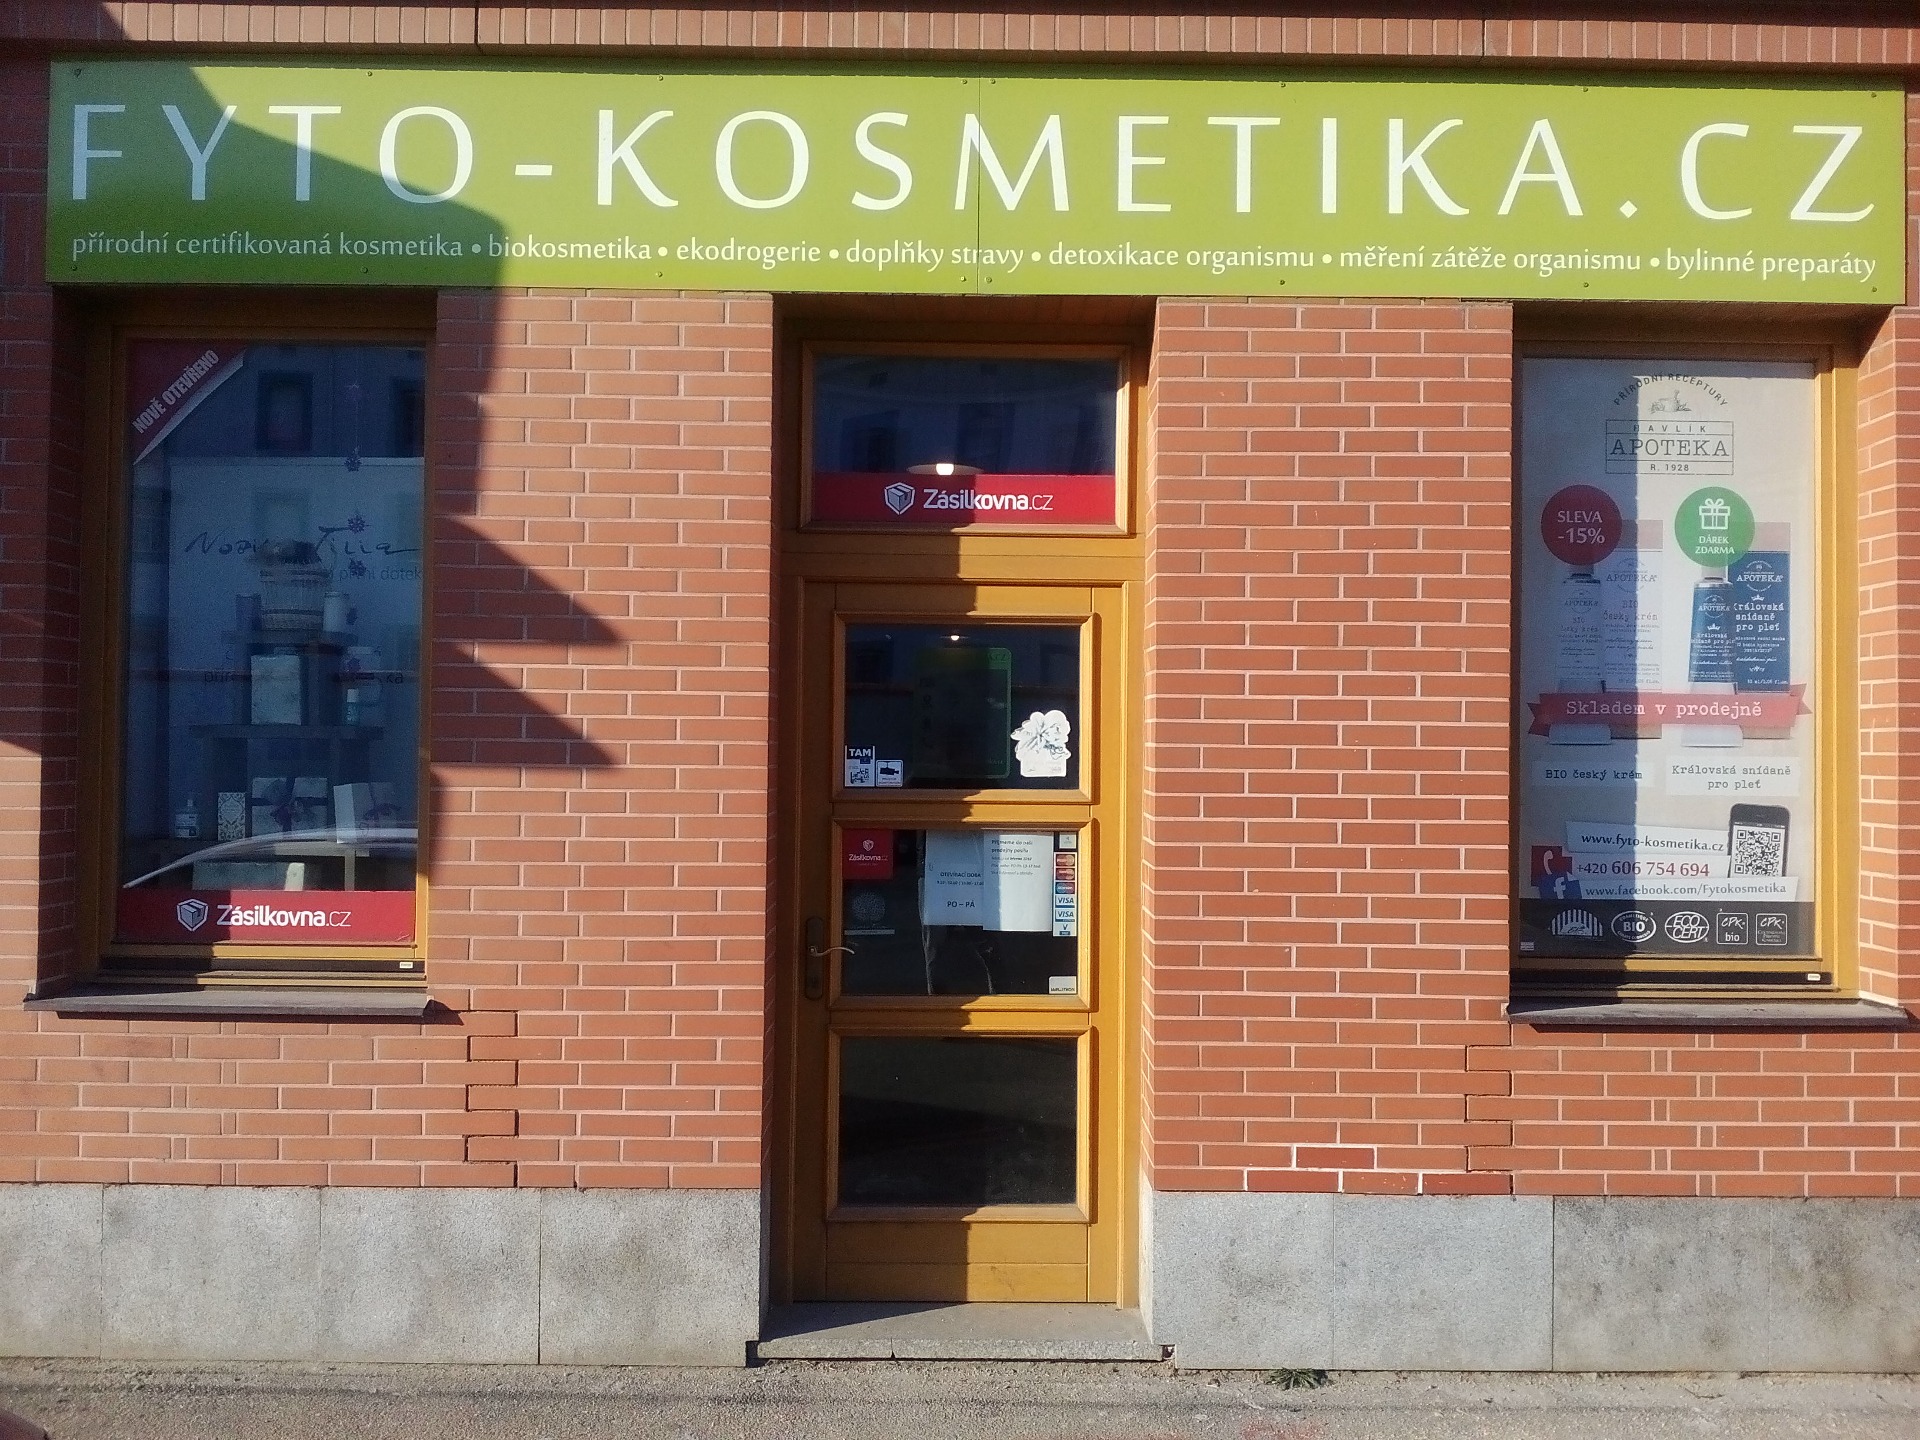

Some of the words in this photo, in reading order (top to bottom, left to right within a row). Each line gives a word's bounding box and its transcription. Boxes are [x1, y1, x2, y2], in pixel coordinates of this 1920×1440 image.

[72, 103, 1875, 225] FYTO-KOSMETIKA.CZ
[72, 232, 168, 260] přírodní
[175, 231, 331, 256] certifikovaná
[339, 232, 463, 257] kosmetika
[489, 234, 652, 261] biokosmetika
[676, 238, 821, 270] ekodrogerie
[846, 240, 944, 272] doplňky
[951, 244, 1024, 273] stravy
[1049, 242, 1179, 267] detoxikace
[1186, 246, 1314, 274] organismu
[1340, 244, 1424, 269] měření
[1431, 245, 1507, 269] zátěže
[1514, 248, 1641, 278] organismu
[1666, 247, 1755, 279] bylinné
[1762, 251, 1876, 283] preparáty
[132, 397, 166, 434] NOVĚ
[162, 349, 220, 405] OTEVŘENO
[1668, 373, 1729, 407] RECEPTURY
[1610, 439, 1730, 456] APOTEKA
[1557, 510, 1603, 523] SLEVA
[1557, 528, 1605, 544] -15%
[1699, 534, 1729, 544] DÁREK
[1695, 545, 1735, 555] ZDARMA
[1735, 624, 1754, 633] pro
[1566, 700, 1645, 715] Skladem
[1655, 704, 1667, 714] v
[1676, 702, 1762, 719] prodejně
[849, 748, 872, 757] TAM
[1545, 769, 1568, 779] BIO
[1573, 768, 1607, 781] český
[1613, 768, 1643, 779] krém
[1672, 765, 1737, 776] Královská
[1742, 765, 1791, 776] snídaně
[1708, 781, 1729, 790] pro
[1734, 779, 1762, 790] pleť
[1581, 833, 1725, 853] www.fyto-kosmetika.cz
[1577, 863, 1607, 875] +420
[1611, 860, 1642, 875] 606
[1646, 861, 1676, 876] 754
[1680, 863, 1710, 877] 694
[1585, 881, 1787, 898] www.facebook.com/Fytokosmetika
[1057, 910, 1075, 918] VISA
[1673, 914, 1701, 927] ECO
[1623, 921, 1646, 932] BIO
[1672, 926, 1706, 939] CERT
[1725, 932, 1740, 942] bio
